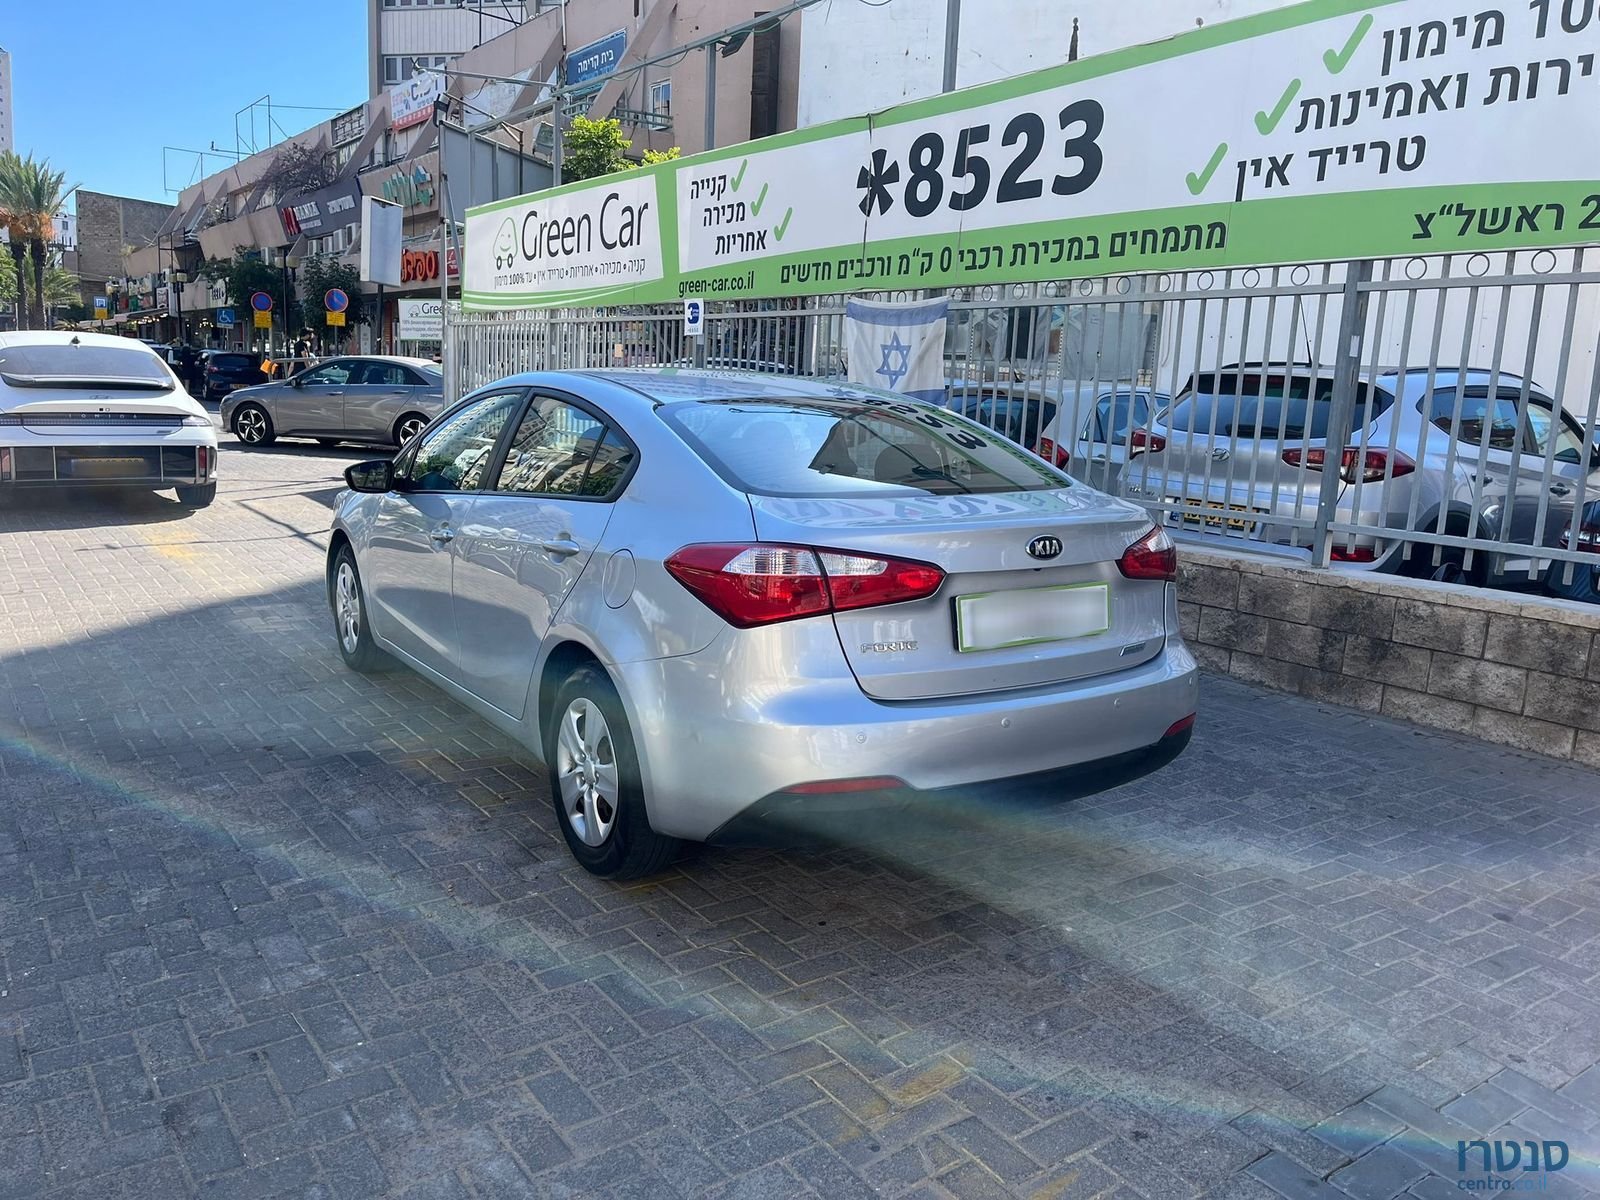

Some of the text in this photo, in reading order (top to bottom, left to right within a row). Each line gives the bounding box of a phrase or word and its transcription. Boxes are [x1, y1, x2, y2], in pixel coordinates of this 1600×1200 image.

[1381, 0, 1600, 77] 10 מימון
[577, 55, 599, 73] קדימה
[601, 49, 614, 64] בית
[1294, 72, 1469, 133] ואמינות
[1234, 135, 1427, 202] טרייד אין
[690, 174, 727, 201] קנייה
[703, 201, 746, 227] מכירה
[522, 192, 649, 261] Green Car
[715, 229, 768, 255] אחריות
[1009, 235, 1100, 267] במכירת
[1109, 221, 1227, 258] מתמחים
[599, 261, 622, 275] מכירה
[627, 258, 646, 275] קניה
[837, 256, 892, 280] ורכבים
[939, 246, 953, 273] 0
[958, 246, 1004, 271] רכבי
[509, 273, 525, 285] 100%
[537, 271, 546, 285] אין
[547, 267, 565, 280] טרייד
[569, 264, 594, 279] אחריות
[780, 261, 832, 283] חדשים
[678, 270, 754, 298] green-car.co.il
[421, 302, 443, 315] Gree
[1033, 539, 1061, 556] KIA
